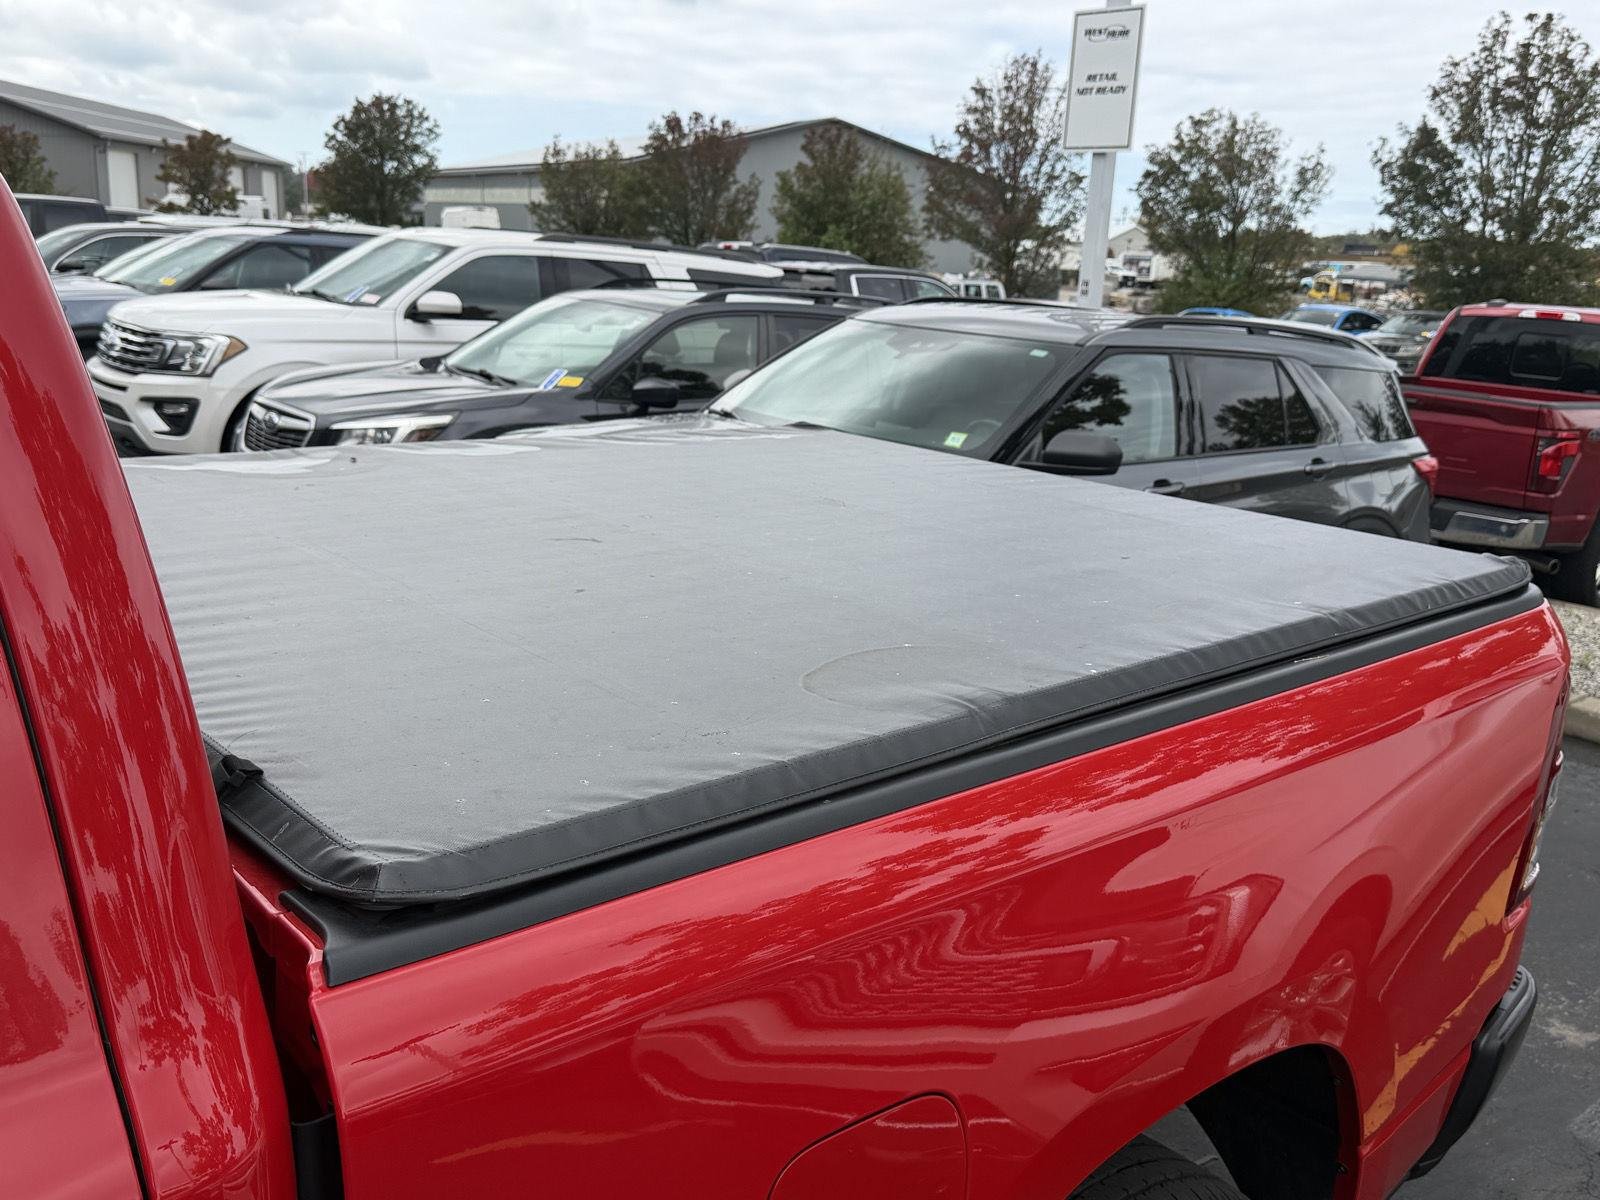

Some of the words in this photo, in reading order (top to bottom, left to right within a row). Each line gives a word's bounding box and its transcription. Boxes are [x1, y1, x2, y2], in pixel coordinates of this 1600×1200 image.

[1086, 73, 1117, 82] RETAIL
[1076, 87, 1094, 96] NOT
[1095, 86, 1127, 95] READY
